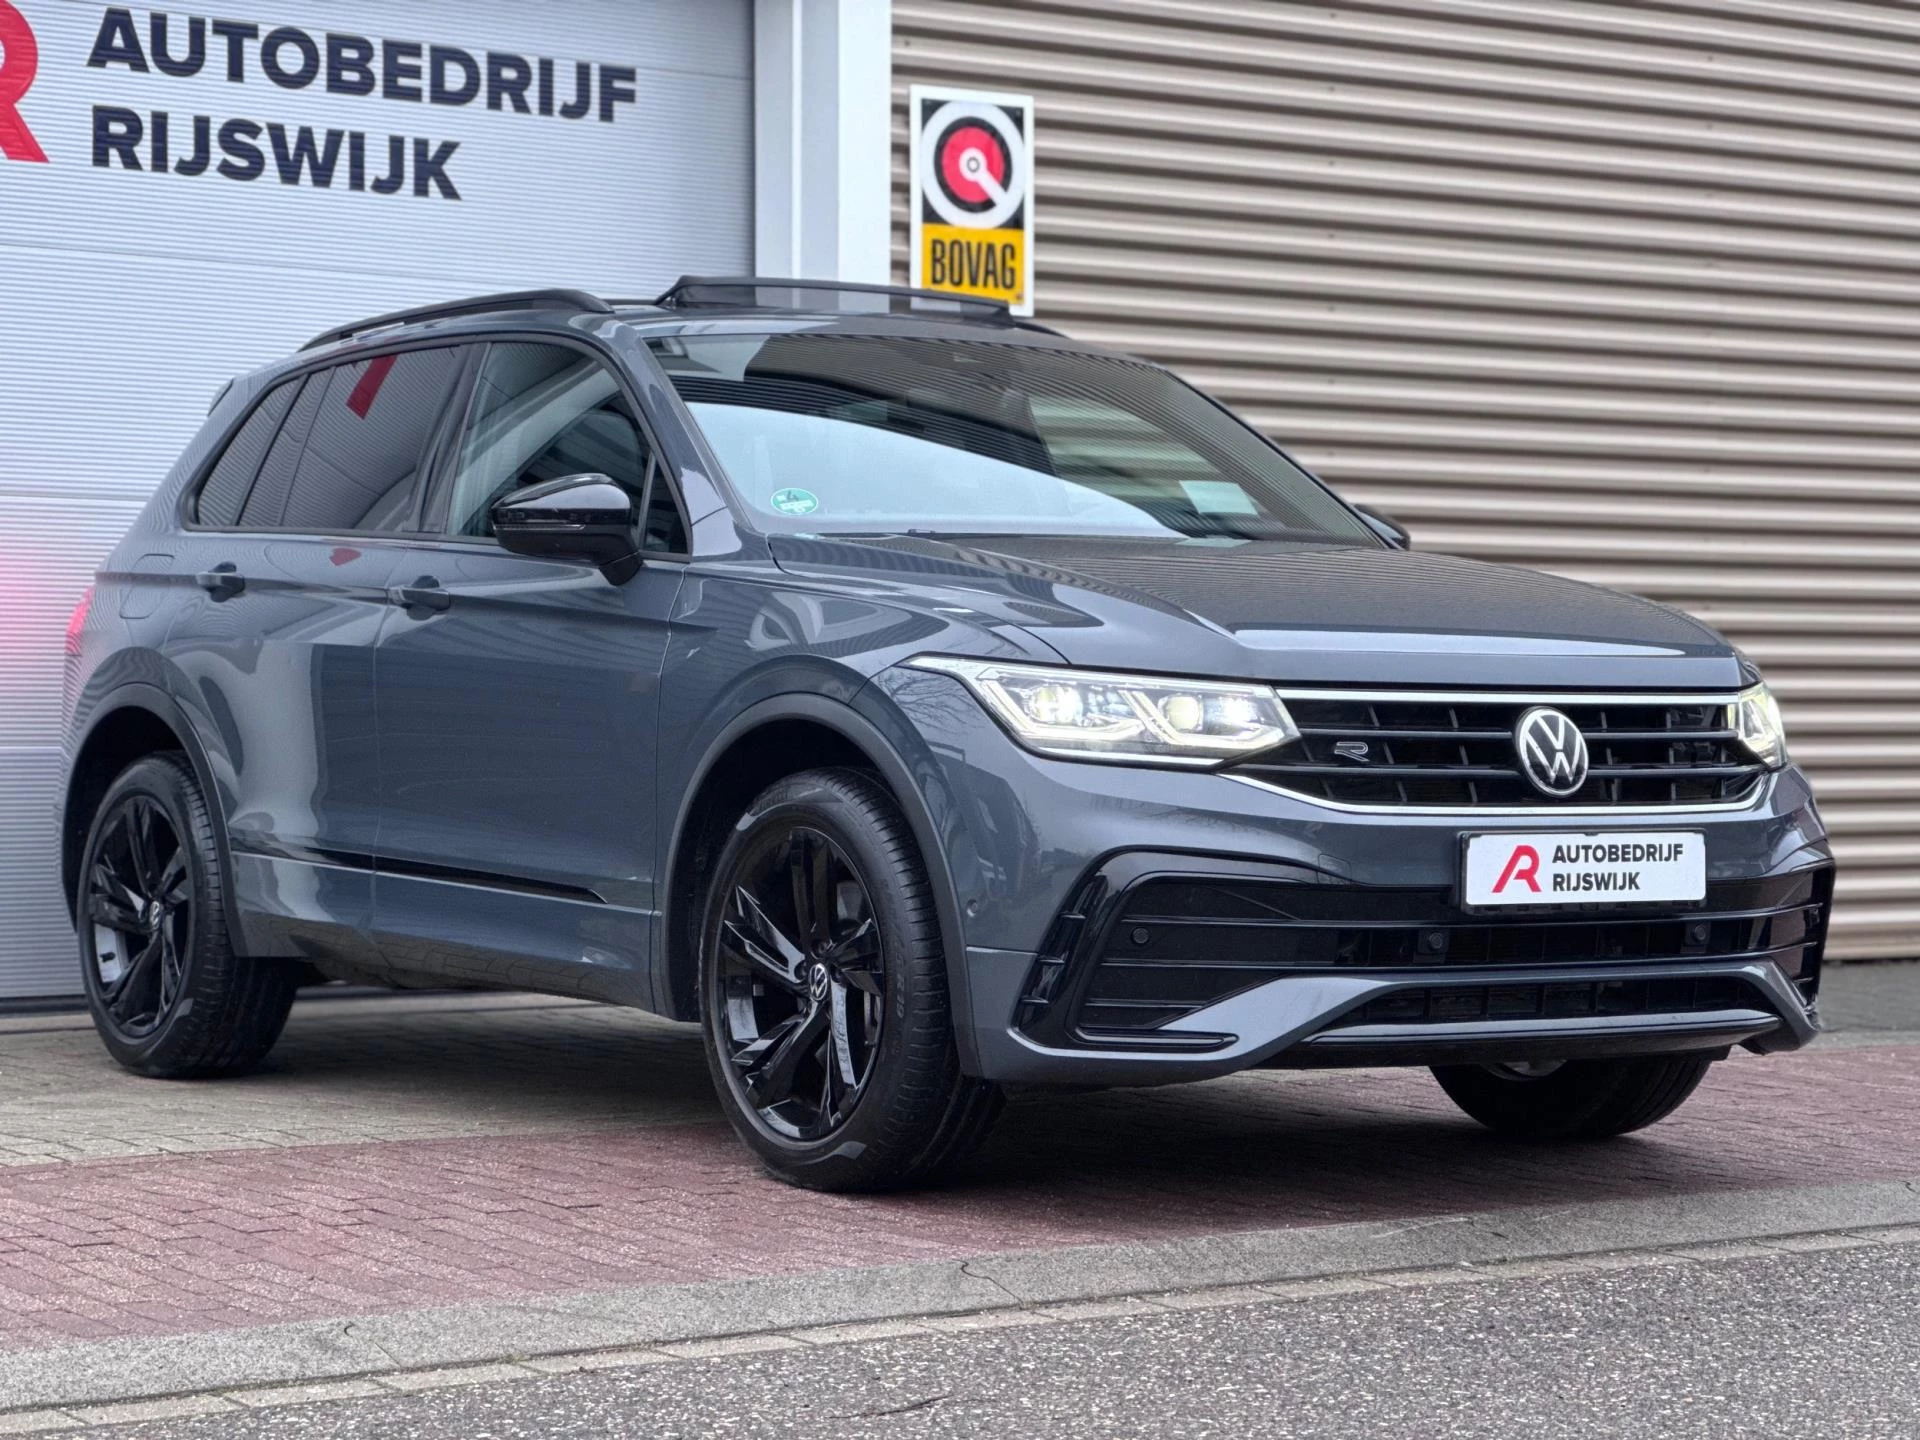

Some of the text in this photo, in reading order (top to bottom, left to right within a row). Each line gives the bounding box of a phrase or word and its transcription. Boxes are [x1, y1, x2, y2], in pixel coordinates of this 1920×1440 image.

[87, 7, 637, 123] AUTOBEDRIJF
[92, 104, 462, 201] RIJSWIJK
[931, 238, 1016, 290] BOVAG
[1552, 843, 1684, 864] AUTOBEDRIJF
[1552, 871, 1641, 892] RIJSWIJK
